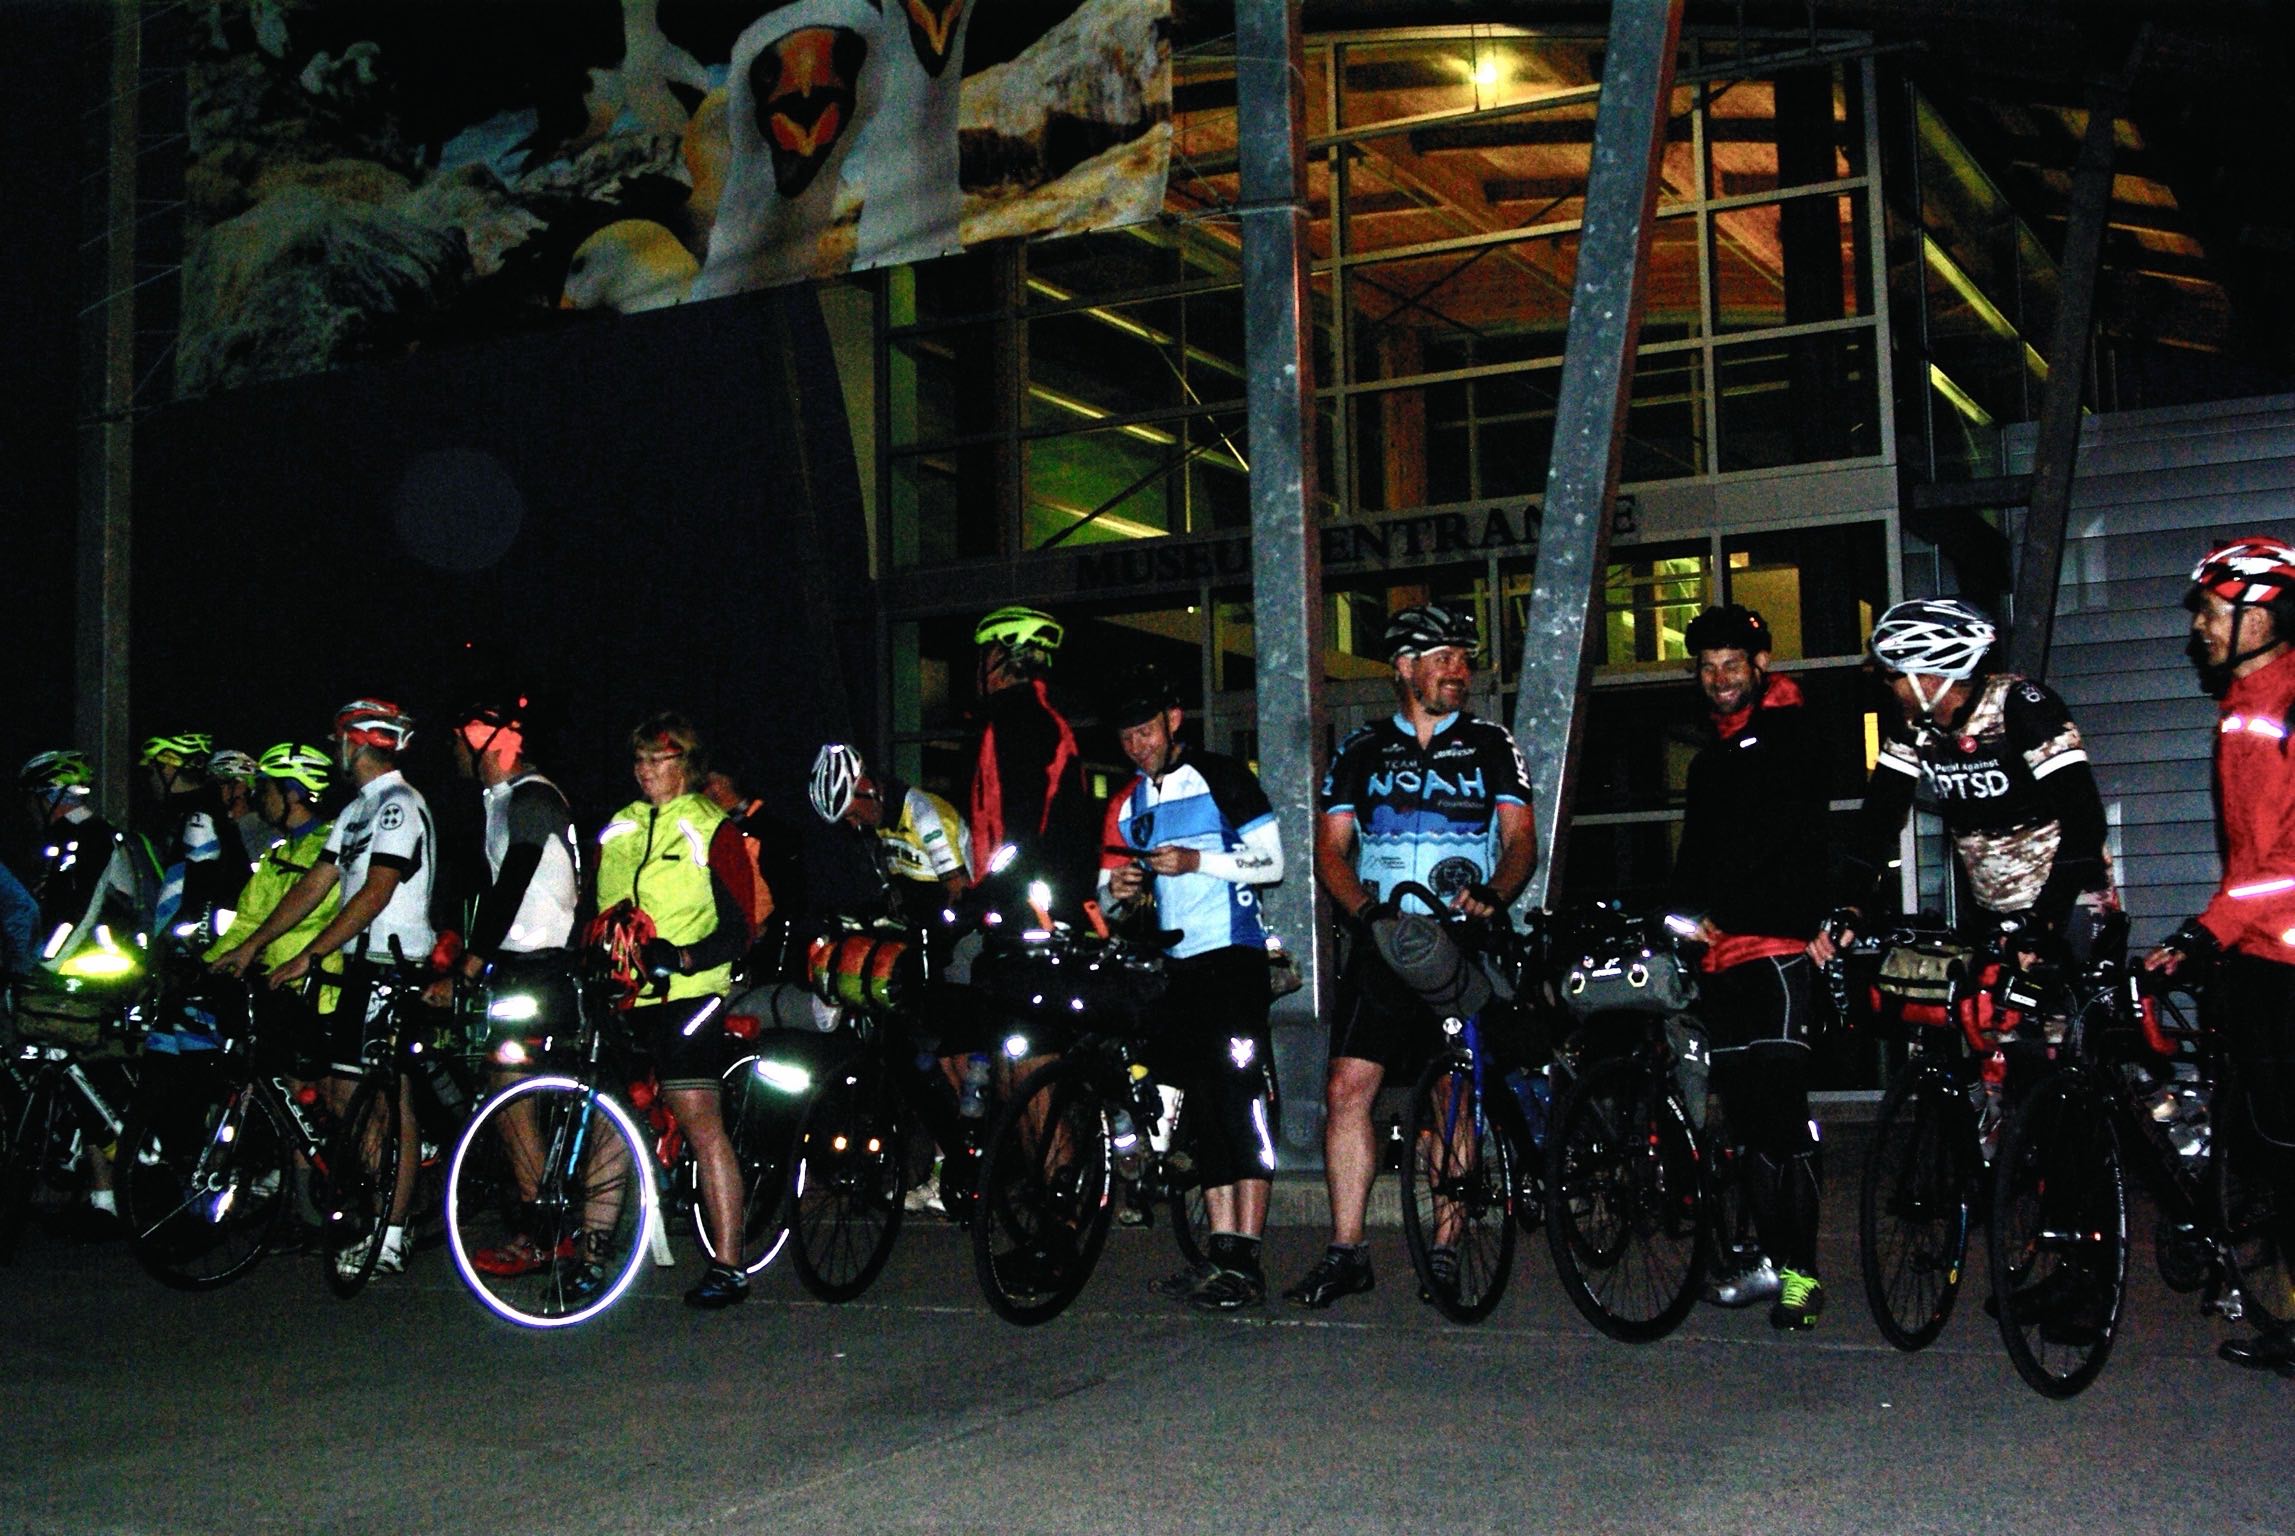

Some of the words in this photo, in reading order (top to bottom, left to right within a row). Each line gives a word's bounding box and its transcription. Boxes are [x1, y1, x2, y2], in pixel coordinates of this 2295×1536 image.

[1077, 537, 1252, 590] MUSEU
[1320, 495, 1635, 566] ENTRAE
[1368, 766, 1486, 800] NOAH
[1937, 770, 2010, 799] PTSD
